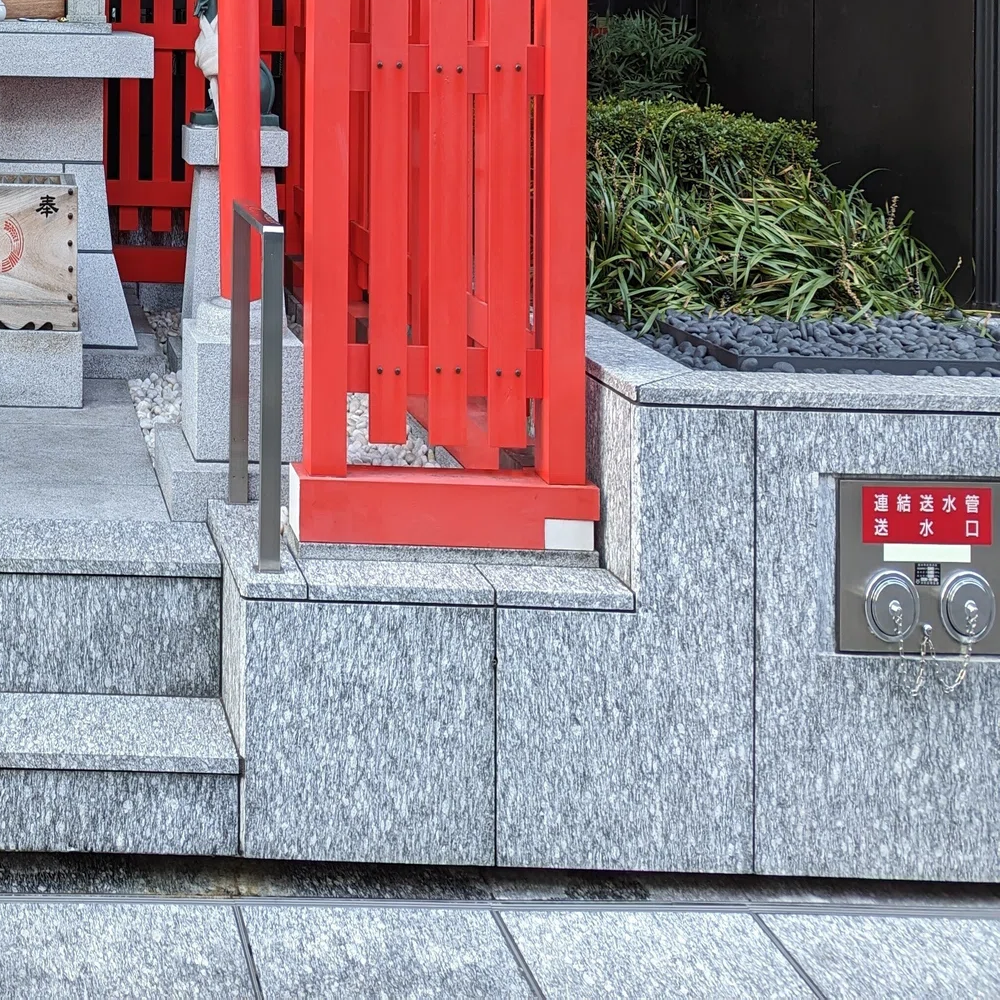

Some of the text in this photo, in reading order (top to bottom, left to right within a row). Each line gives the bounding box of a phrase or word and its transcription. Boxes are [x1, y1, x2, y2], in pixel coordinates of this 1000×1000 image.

[874, 494, 980, 514] 連結送水管
[874, 518, 979, 537] 送水口
